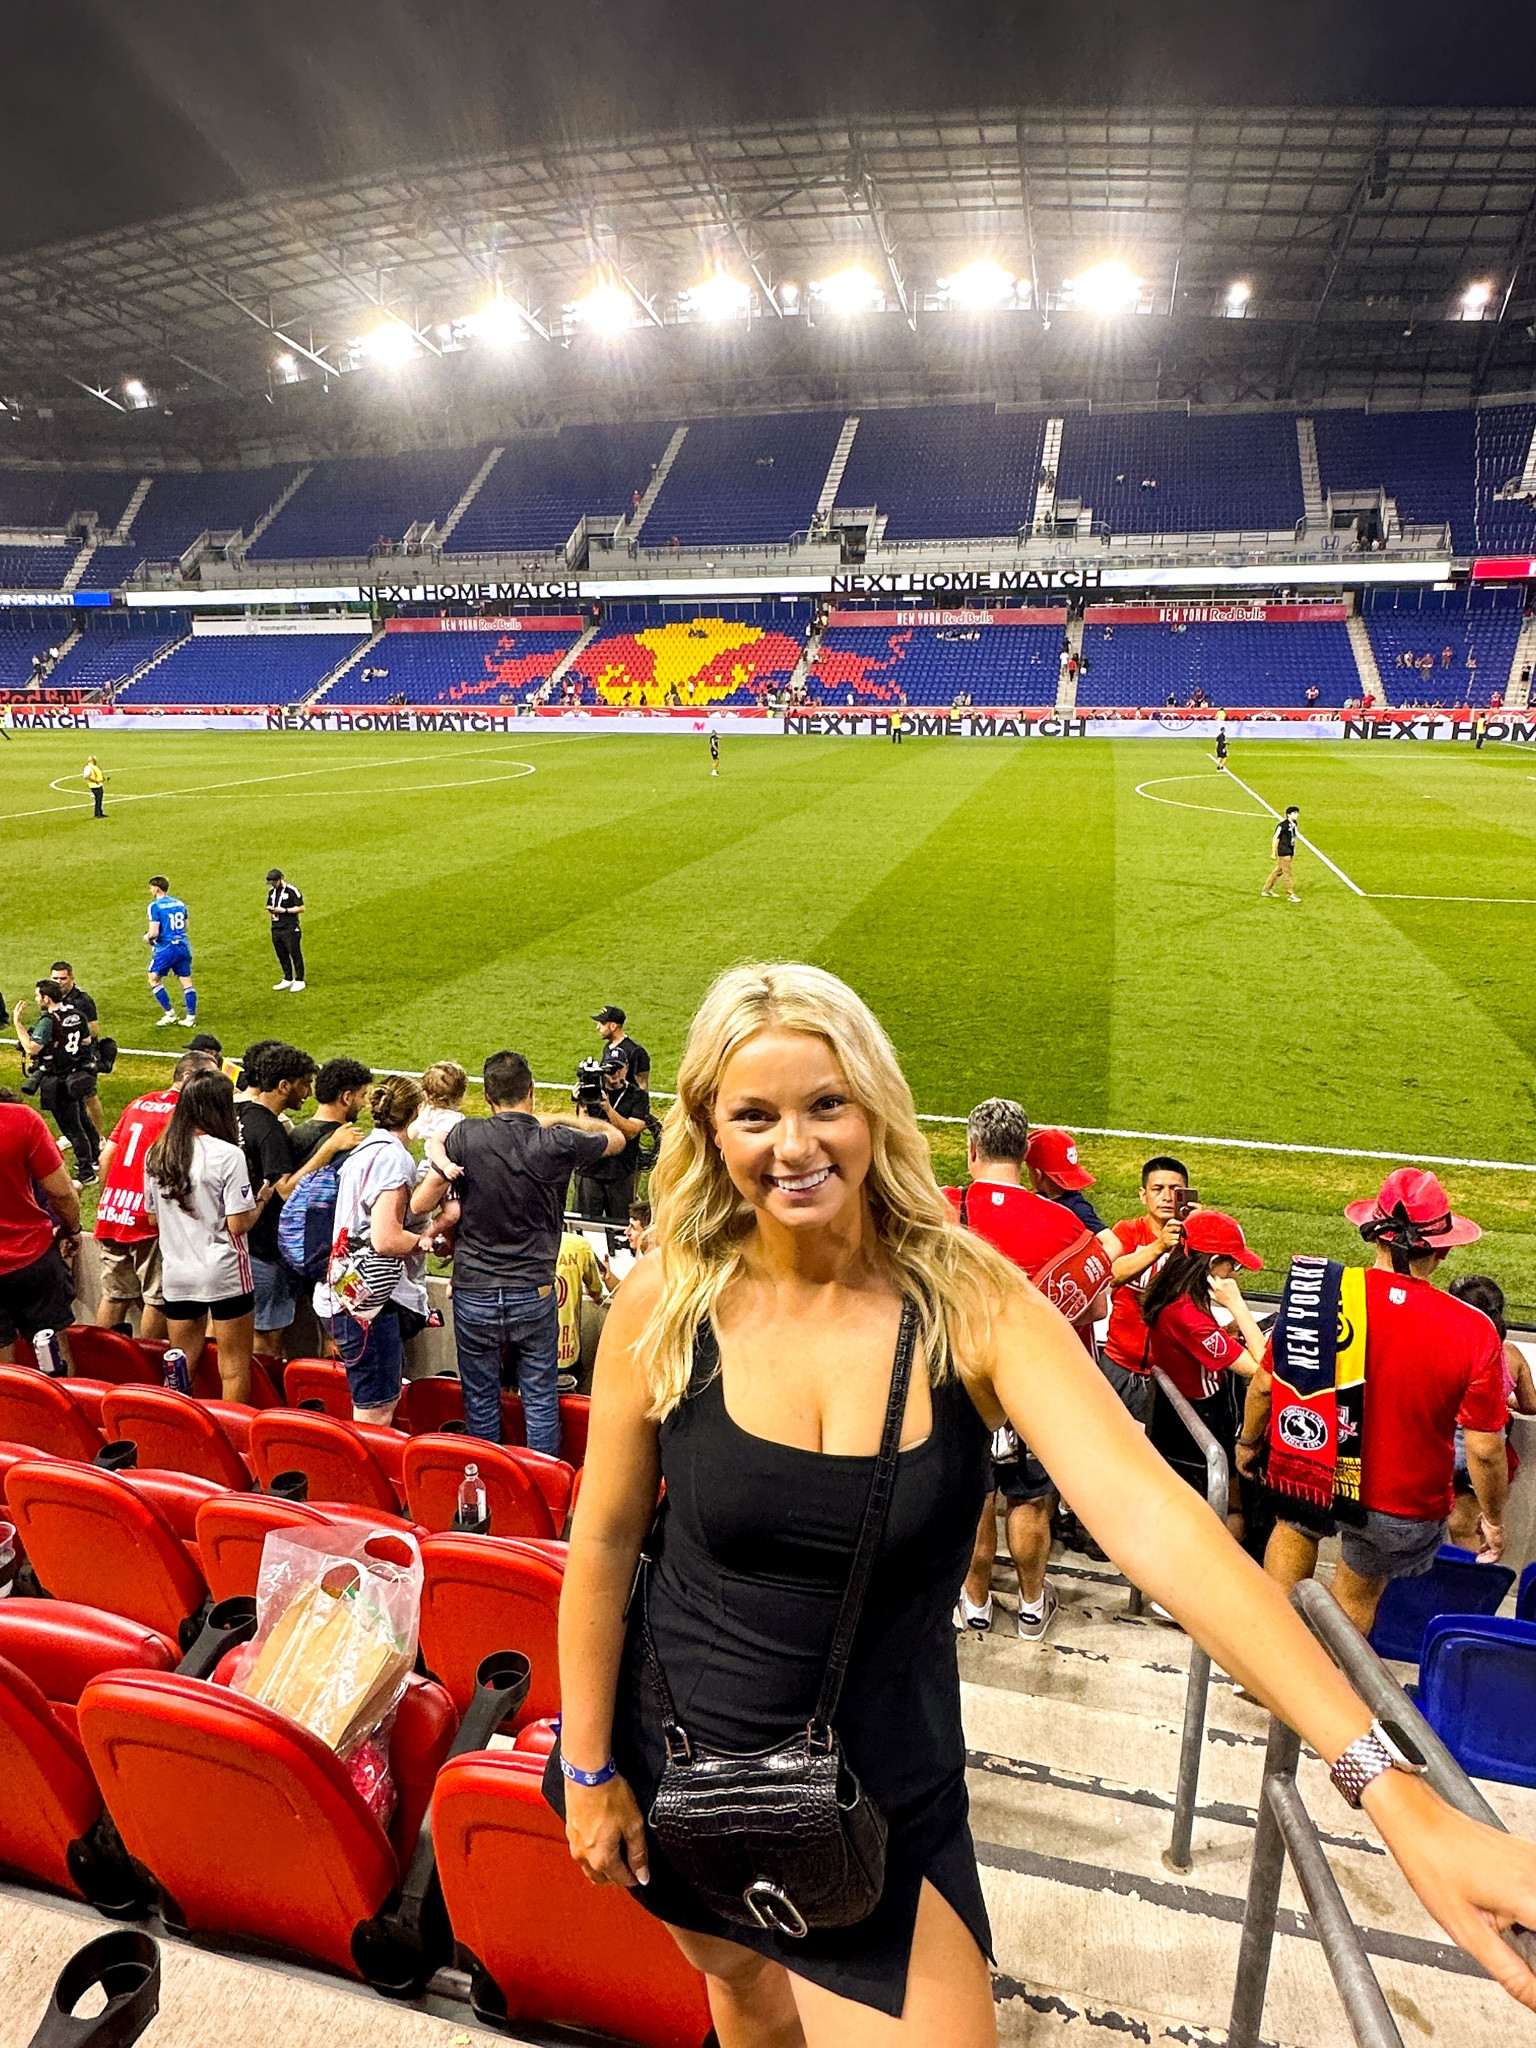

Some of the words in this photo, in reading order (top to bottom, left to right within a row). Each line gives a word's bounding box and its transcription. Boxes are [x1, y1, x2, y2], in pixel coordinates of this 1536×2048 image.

[830, 574, 899, 592] NEXT
[910, 573, 990, 591] HOME
[1001, 570, 1099, 590] MATCH
[0, 594, 74, 606] INCINNATI
[359, 586, 418, 601] NEXT
[424, 584, 491, 600] HOME
[496, 582, 580, 600] MATCH
[897, 612, 915, 626] NEW
[942, 612, 966, 625] Red
[967, 611, 994, 625] Bulls
[1159, 608, 1180, 622] NEW
[1183, 608, 1208, 622] YORK
[1210, 607, 1236, 621] Red
[1237, 607, 1267, 621] Bulls
[479, 619, 500, 631] Red
[501, 619, 522, 631] Bulls
[12, 714, 90, 728] MATCH
[267, 714, 331, 731] NEXT
[337, 714, 411, 731] HOME
[416, 715, 508, 732] MATCH
[784, 718, 864, 735] NEXT
[871, 719, 963, 736] HOME
[970, 719, 1086, 737] MATCH
[1343, 722, 1443, 739] NEXT
[168, 911, 185, 931] 18
[122, 1122, 144, 1167] 1
[106, 1206, 136, 1226] Bulls
[1287, 1265, 1325, 1319] YORK
[1286, 1325, 1320, 1370] NEW
